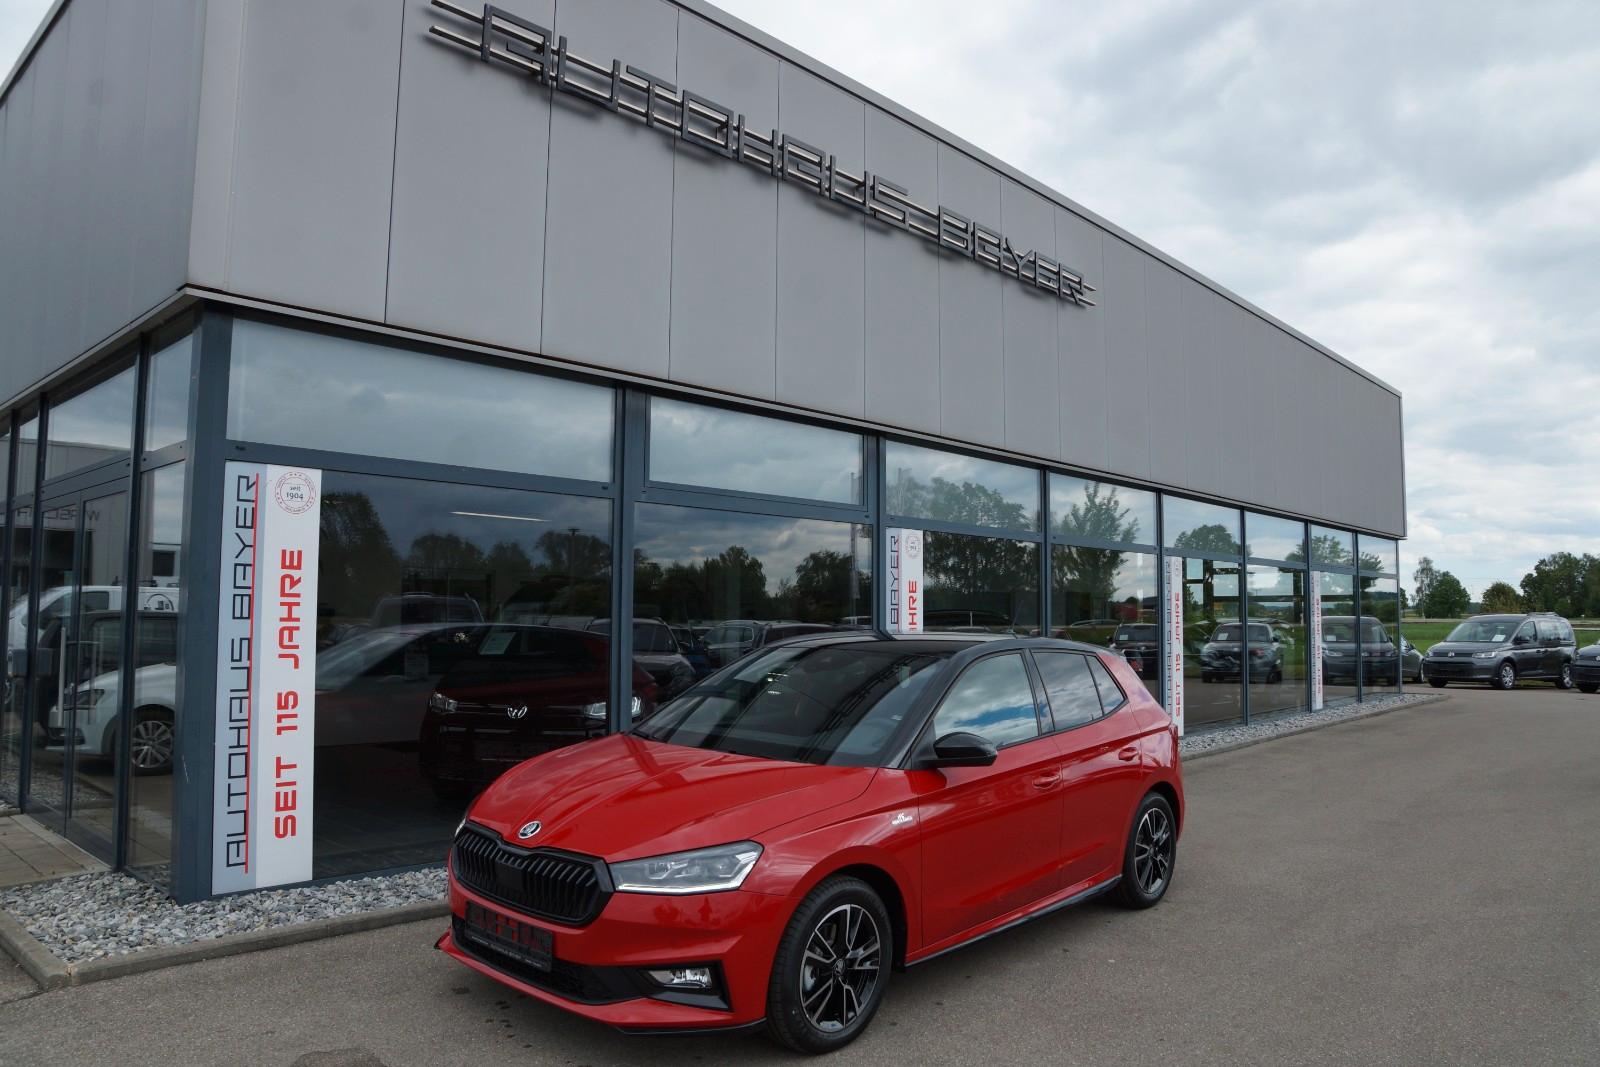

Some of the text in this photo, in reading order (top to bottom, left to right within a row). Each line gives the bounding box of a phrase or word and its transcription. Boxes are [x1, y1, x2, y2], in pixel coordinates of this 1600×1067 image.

[481, 2, 1086, 304] AUTOHAUS BAYER
[286, 492, 304, 502] 1904
[890, 535, 899, 625] BAYER
[226, 475, 258, 869] AUTOHAUS BAYER
[274, 549, 303, 840] SEIT 115 JAHRE
[908, 580, 917, 631] HRE
